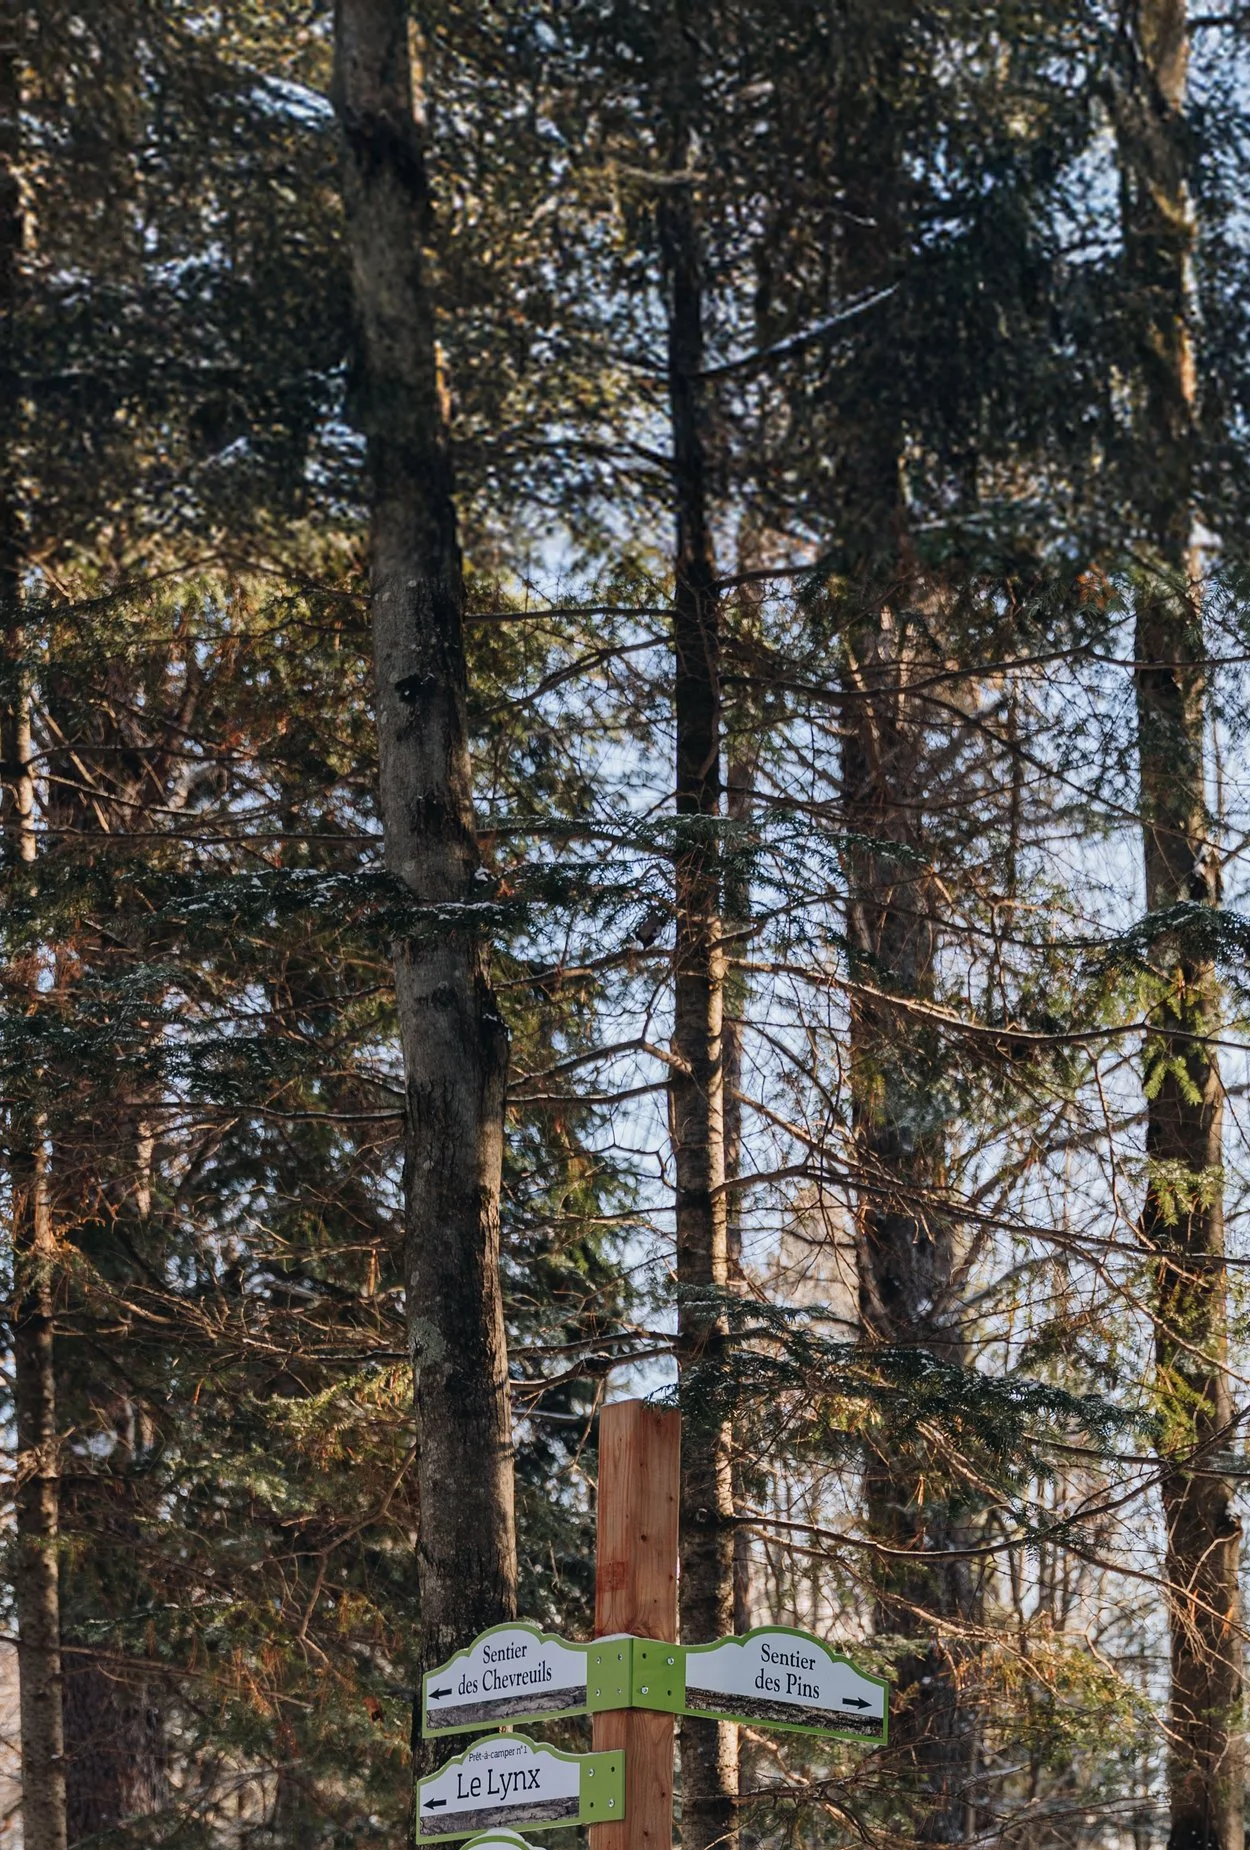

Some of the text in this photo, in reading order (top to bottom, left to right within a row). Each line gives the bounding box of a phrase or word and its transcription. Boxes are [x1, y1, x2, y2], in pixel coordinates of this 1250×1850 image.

[483, 1642, 527, 1664] Sentier
[761, 1643, 816, 1670] Sentier
[458, 1660, 552, 1695] des Chevreuils
[755, 1668, 820, 1699] des Pins
[469, 1748, 515, 1762] Prêt-à-camper
[457, 1768, 540, 1801] Le Lynx
